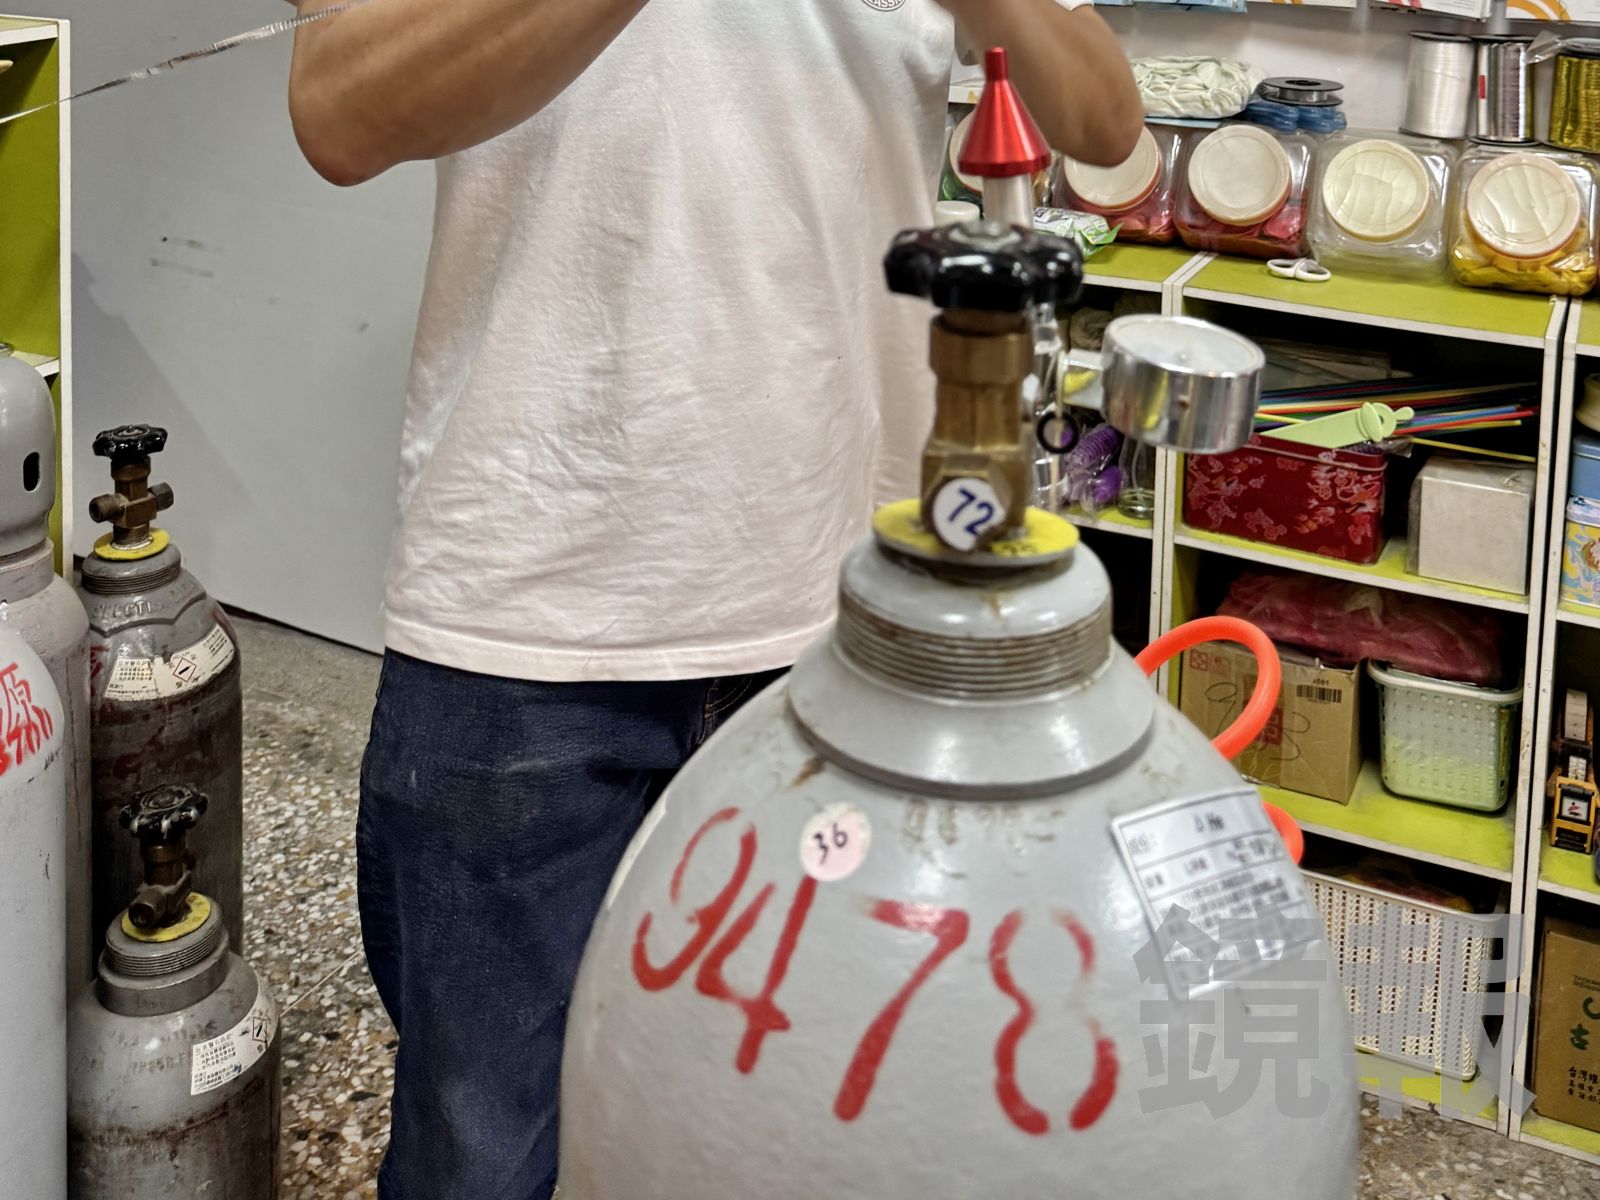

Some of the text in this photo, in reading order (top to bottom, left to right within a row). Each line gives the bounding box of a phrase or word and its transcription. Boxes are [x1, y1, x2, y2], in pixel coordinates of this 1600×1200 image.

[947, 487, 995, 535] 72
[812, 823, 850, 865] 36
[632, 805, 1120, 1137] 9478
